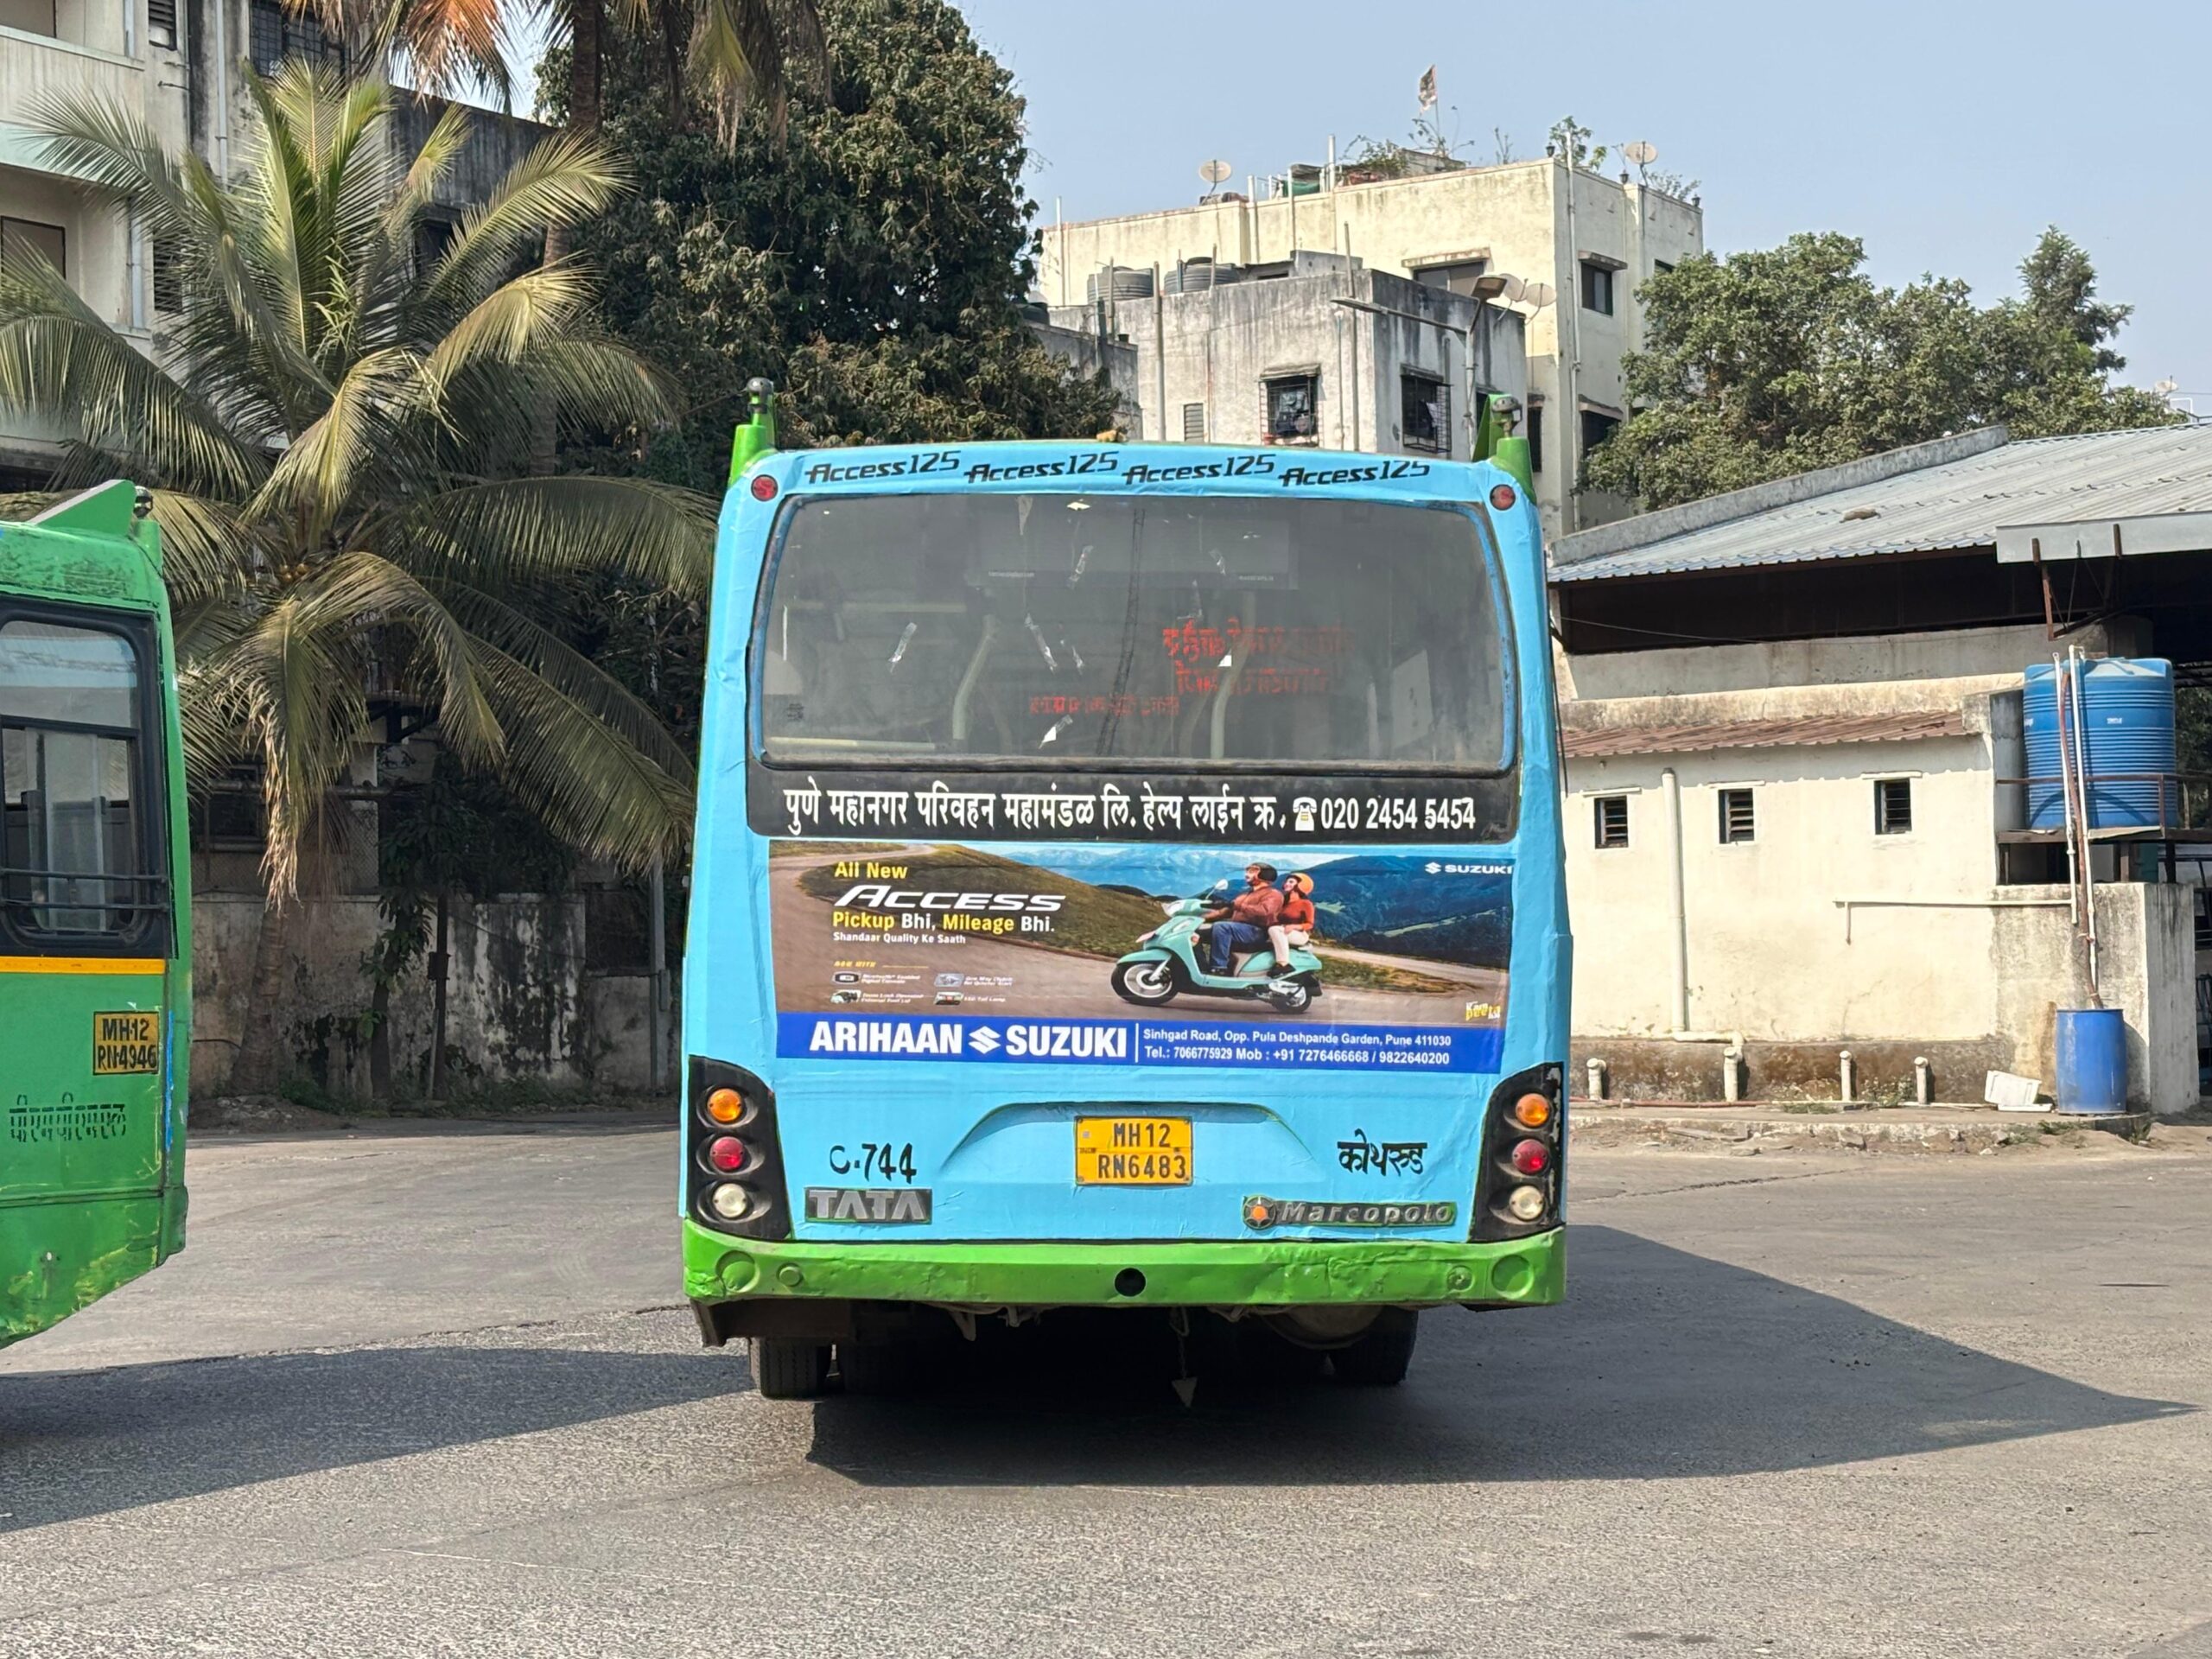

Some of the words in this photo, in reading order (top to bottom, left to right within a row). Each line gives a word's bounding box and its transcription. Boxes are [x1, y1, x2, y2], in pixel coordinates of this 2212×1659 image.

[783, 776, 822, 836] पुणे
[827, 790, 908, 826] महानगर
[914, 780, 996, 830] परिवहन
[1001, 782, 1096, 830] महामंडळ
[1101, 783, 1136, 828] लि.
[1140, 781, 1184, 830] हेल्प
[1189, 784, 1245, 834] लाईन
[1321, 798, 1359, 830] 020
[1366, 798, 1418, 830] 2454
[1424, 797, 1476, 830] 5454
[835, 861, 859, 878] All
[867, 862, 907, 879] New
[1445, 865, 1512, 874] SUZUKI
[834, 885, 1066, 912] ACCESS
[832, 912, 894, 931] Pickup
[901, 913, 937, 931] Bhi,
[943, 914, 1014, 934] Mileage
[1020, 916, 1055, 932] Bhi.
[833, 932, 880, 943] Shandaar
[883, 933, 918, 944] Quality
[921, 934, 934, 944] Ke
[938, 935, 966, 944] Saath
[810, 1021, 962, 1054] ARIHAAN
[1006, 1025, 1127, 1057] SUZUKI
[1143, 1028, 1187, 1043] Sinhgad
[1191, 1030, 1221, 1042] Road,
[1224, 1031, 1249, 1044] Opp.
[1252, 1031, 1276, 1042] Pula
[1279, 1032, 1338, 1046] Deshpande
[1341, 1033, 1382, 1046] Garden,
[1385, 1034, 1412, 1046] Pune
[1414, 1034, 1452, 1046] 411030
[1173, 1046, 1232, 1059] 7066775929
[1236, 1047, 1262, 1060] Mob
[1273, 1049, 1294, 1061] +91
[1299, 1050, 1369, 1063] 7276466668
[1379, 1051, 1450, 1065] 9822640200
[1098, 1154, 1186, 1179] RN6483
[809, 1191, 927, 1220] TATA
[1281, 1202, 1452, 1224] Marcopolo
